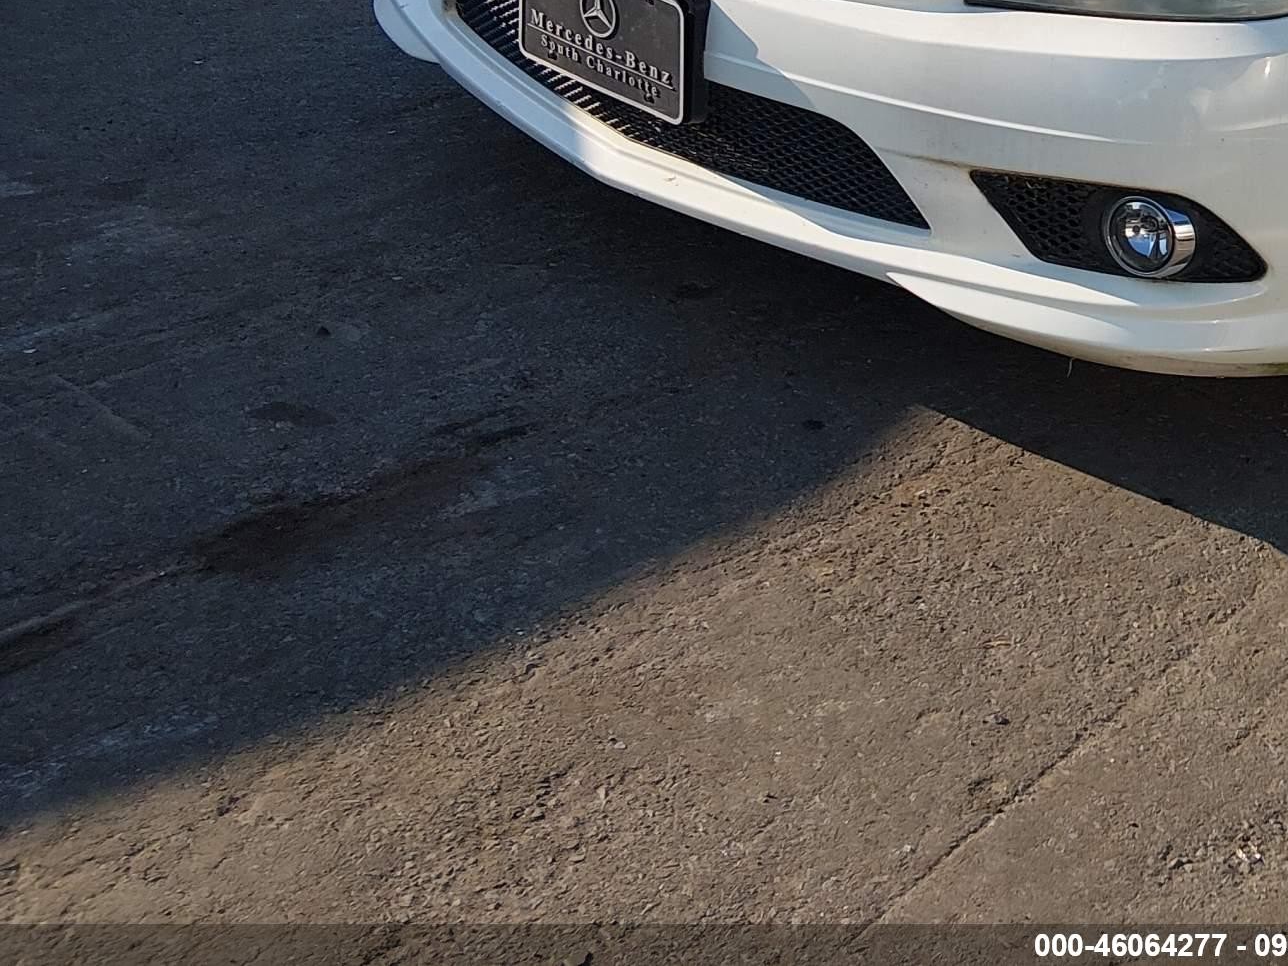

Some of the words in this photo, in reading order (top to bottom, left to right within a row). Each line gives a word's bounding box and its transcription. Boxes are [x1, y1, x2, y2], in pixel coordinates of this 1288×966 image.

[530, 8, 672, 85] Mercedes-Benz
[540, 33, 579, 62] South
[586, 54, 659, 96] Charlotte
